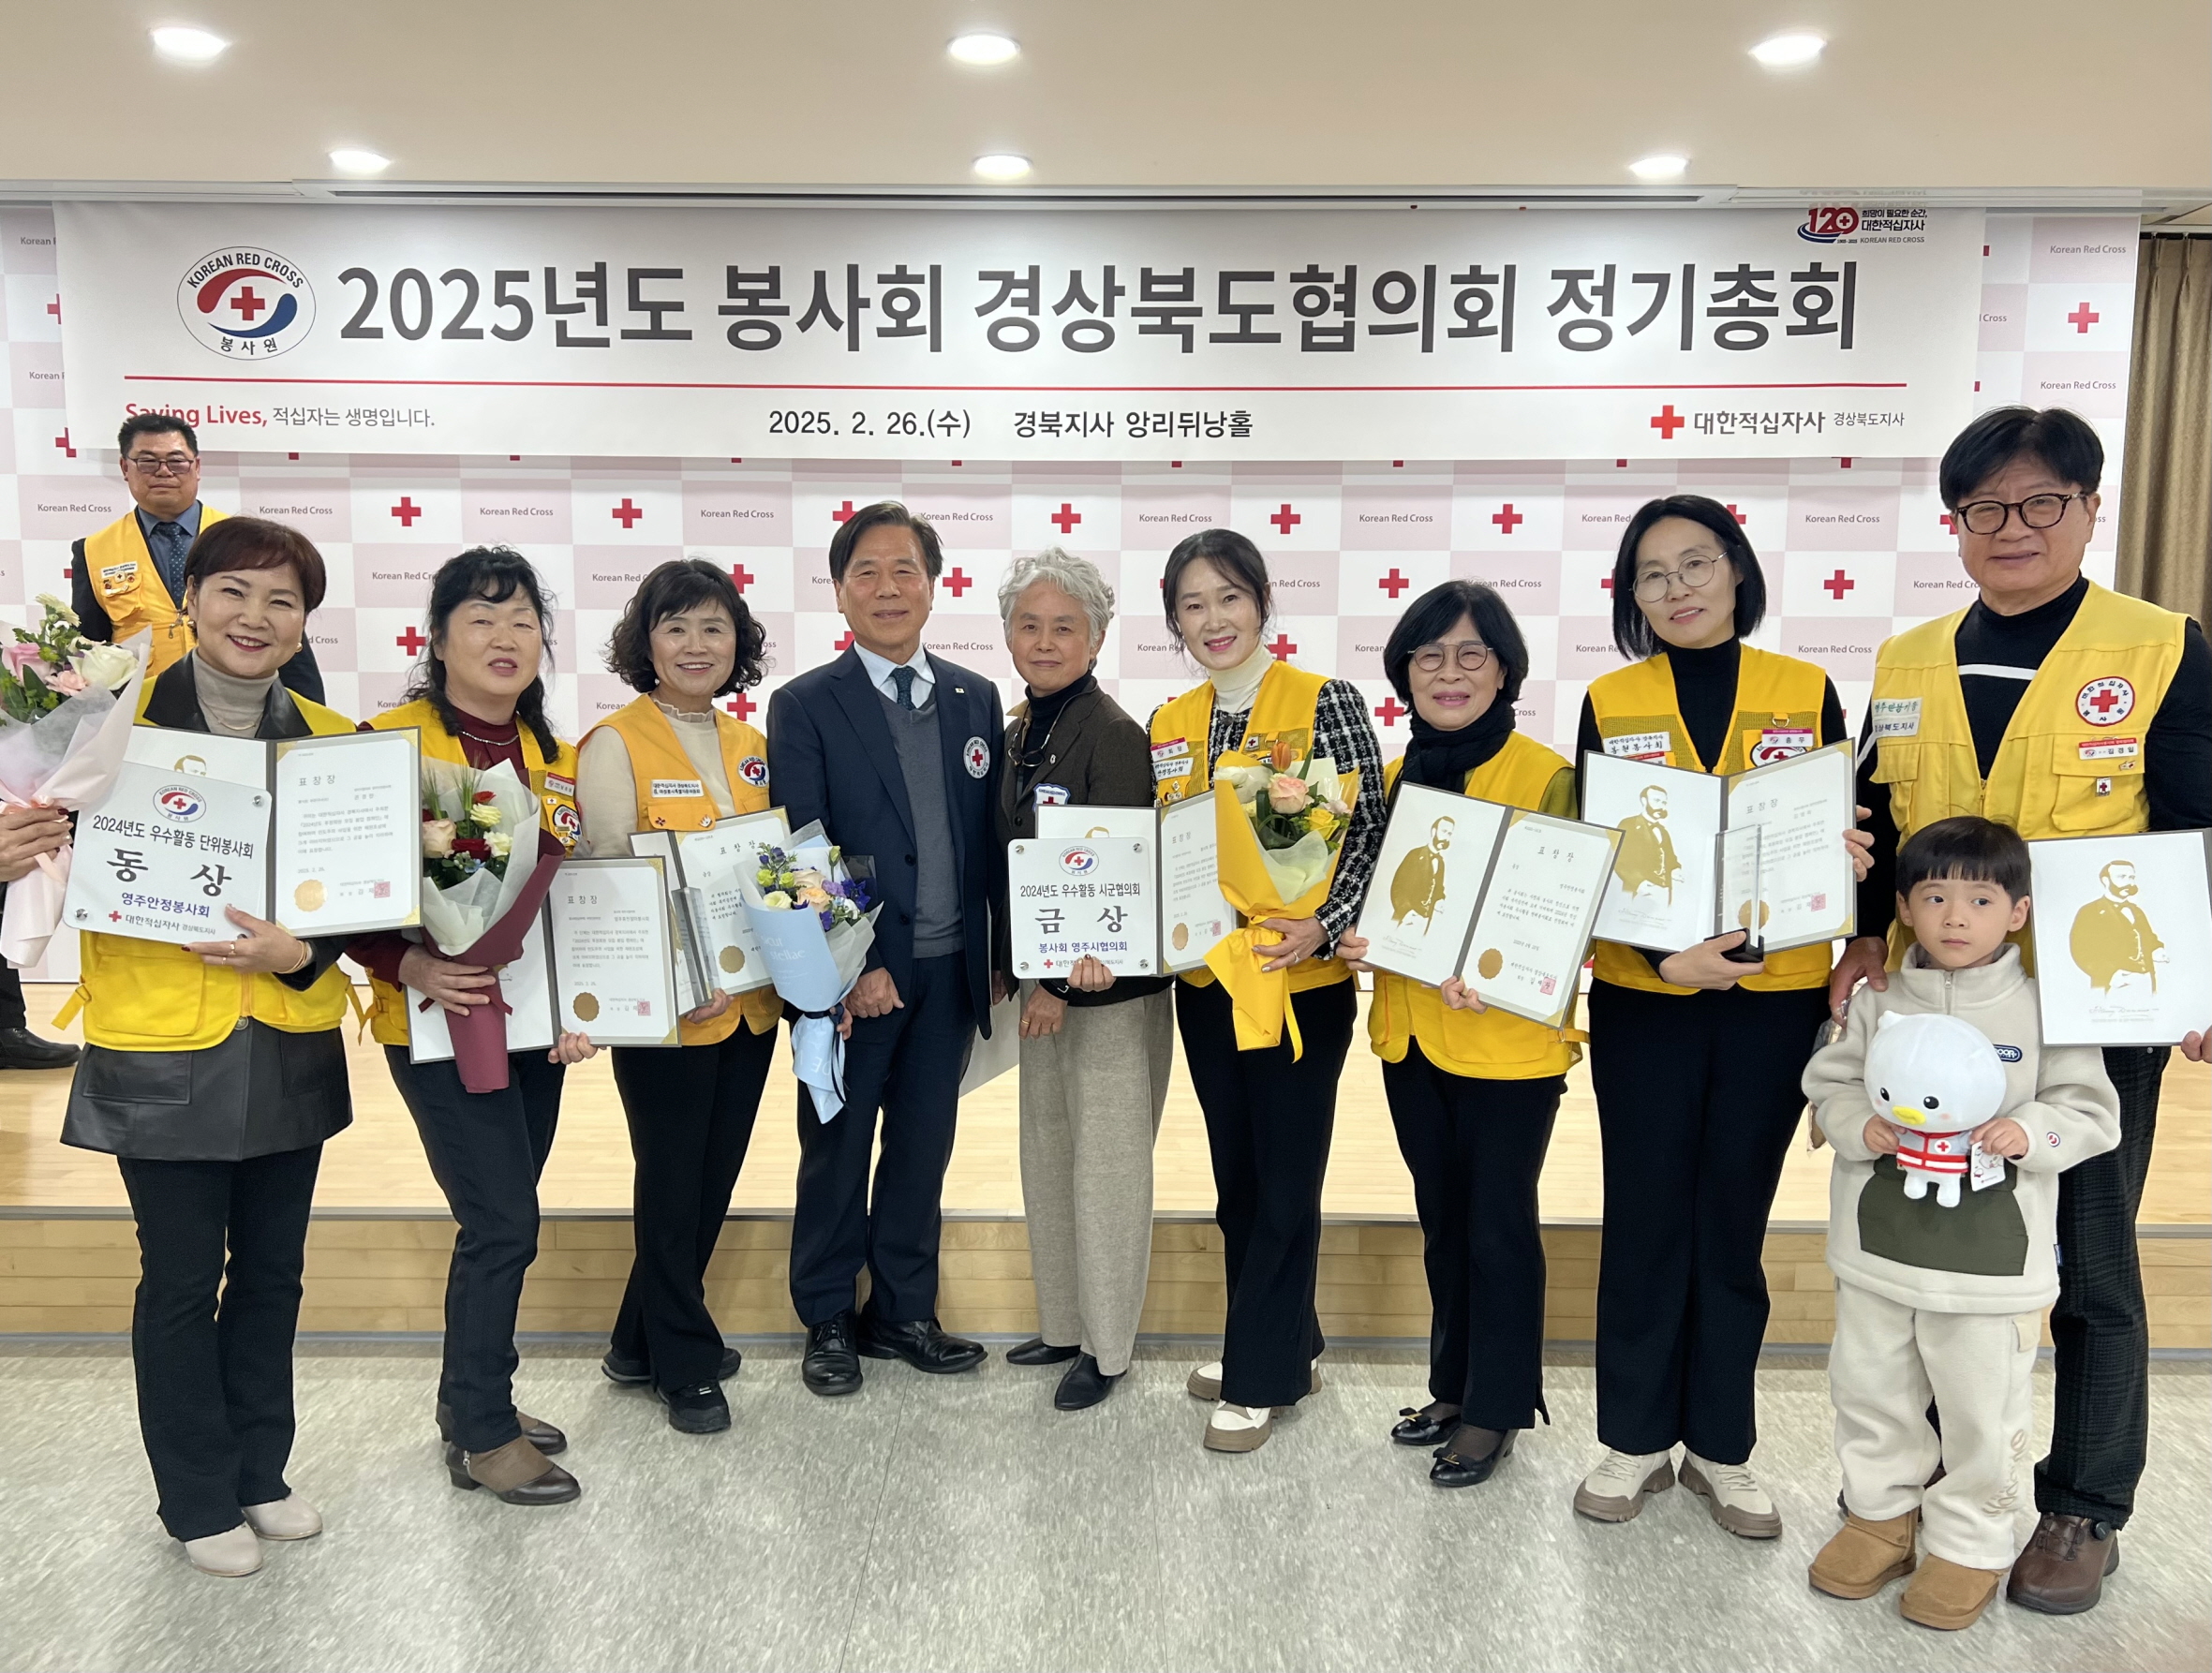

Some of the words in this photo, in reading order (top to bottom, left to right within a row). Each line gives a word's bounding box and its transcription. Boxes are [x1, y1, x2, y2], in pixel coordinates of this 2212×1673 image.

[1862, 209, 1885, 218] 희망이
[1887, 209, 1909, 218] 필요한
[1910, 209, 1928, 218] 순간,
[1861, 219, 1926, 231] 대한적십자사
[20, 236, 52, 246] Korean
[2049, 244, 2082, 254] Korean
[2083, 244, 2101, 254] Red
[2101, 244, 2127, 254] Cross
[186, 254, 233, 289] KOREAN
[235, 252, 260, 266] RED
[264, 257, 304, 289] CROSS
[337, 260, 693, 348] 2025년도
[718, 263, 943, 353] 봉사회
[974, 263, 1517, 353] 경상북도협의회
[1547, 260, 1858, 353] 정기총회
[1982, 313, 2008, 322] Cross
[28, 372, 60, 381] Korean
[2040, 380, 2071, 390] Korean
[2073, 380, 2091, 390] Red
[2092, 380, 2116, 390] Cross
[206, 405, 268, 428] Lives,
[272, 406, 341, 426] 적십자는
[345, 407, 436, 427] 생명입니다.
[768, 410, 840, 437] 2025.
[851, 410, 874, 437] 2.
[1013, 410, 1115, 438] 경북지사
[1124, 410, 1254, 439] 앙리뒤낭홀
[1693, 410, 1826, 435] 대한적십자사
[1833, 410, 1905, 428] 경상북도지사
[37, 503, 68, 512] Korean
[69, 503, 87, 512] Red
[87, 503, 112, 513] Cross
[259, 505, 290, 515] Korean
[290, 505, 308, 515] Red
[309, 506, 334, 515] Cross
[480, 507, 511, 516] Korean
[512, 507, 529, 516] Red
[529, 507, 554, 516] Cross
[700, 509, 732, 518] Korean
[732, 509, 750, 518] Red
[750, 510, 775, 519] Cross
[920, 511, 951, 521] Korean
[952, 511, 970, 521] Red
[970, 512, 994, 522] Cross
[1138, 513, 1169, 523] Korean
[1170, 513, 1188, 523] Red
[1188, 513, 1212, 523] Cross
[1358, 513, 1390, 523] Korean
[1391, 513, 1409, 523] Red
[1409, 513, 1433, 523] Cross
[1581, 513, 1612, 523] Korean
[1613, 513, 1631, 523] Red
[1804, 514, 1836, 524] Korean
[1837, 513, 1855, 524] Red
[1856, 514, 1880, 524] Cross
[372, 571, 403, 581] Korean
[404, 571, 422, 581] Red
[592, 573, 623, 583] Korean
[624, 573, 642, 583] Red
[1279, 579, 1296, 588] Red
[1297, 579, 1321, 588] Cross
[1500, 579, 1518, 588] Red
[1518, 579, 1542, 588] Cross
[1913, 580, 1944, 589] Korean
[1945, 580, 1964, 589] Red
[315, 635, 339, 644] Cross
[952, 642, 970, 651] Red
[970, 642, 994, 651] Cross
[1136, 644, 1167, 653] Korean
[1355, 644, 1386, 653] Korean
[1575, 644, 1607, 653] Korean
[1797, 644, 1829, 654] Korean
[1830, 644, 1848, 654] Red
[1848, 644, 1873, 654] Cross
[93, 815, 145, 838] 2024년도
[149, 825, 196, 849] 우수활동
[200, 835, 254, 859] 단위봉사회
[106, 848, 149, 882] 동
[190, 864, 232, 897] 상
[1019, 884, 1059, 898] 2024년도
[1061, 883, 1096, 897] 우수활동
[1099, 882, 1140, 896] 시군협의회
[121, 892, 211, 918] 영주안정봉사회
[125, 913, 182, 932] 대한적십자사
[1034, 908, 1065, 935] 금
[1096, 905, 1129, 933] 상
[1038, 942, 1067, 954] 봉사회
[1071, 940, 1128, 953] 영주시협의회
